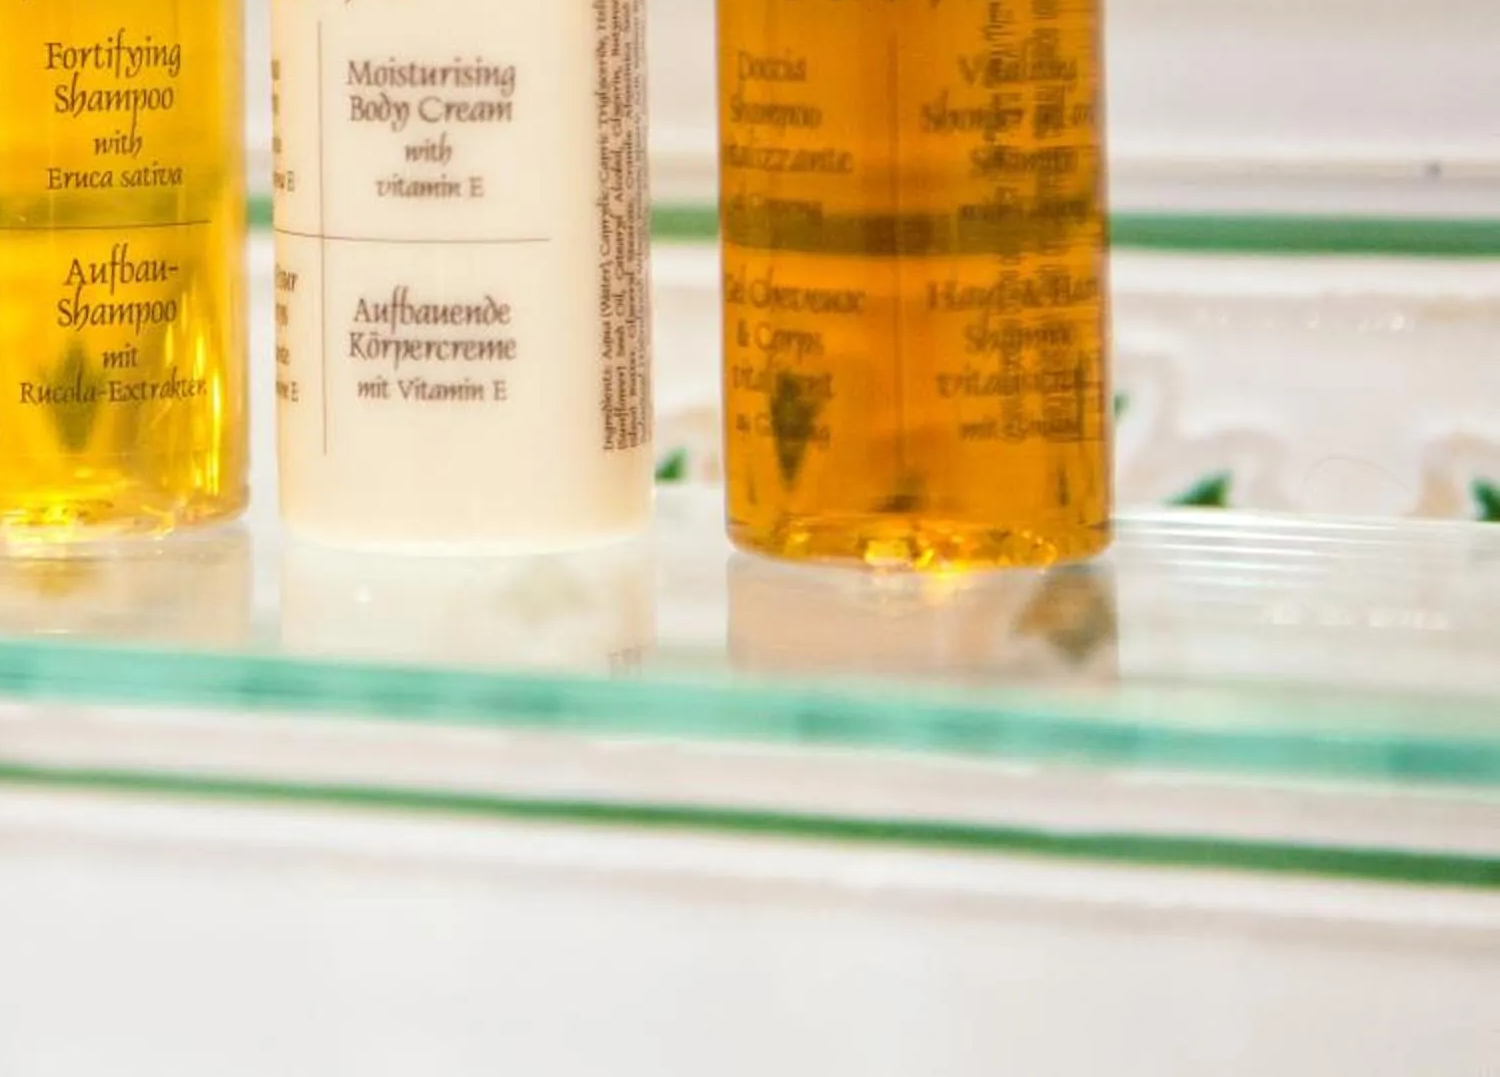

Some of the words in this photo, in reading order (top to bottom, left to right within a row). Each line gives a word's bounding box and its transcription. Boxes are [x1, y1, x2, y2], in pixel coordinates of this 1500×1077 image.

[45, 27, 183, 80] Fortifying
[53, 71, 175, 122] Shampoo
[345, 56, 517, 97] Moisturising
[348, 91, 410, 133] Body
[417, 94, 514, 125] Cream
[94, 121, 144, 159] with
[403, 130, 453, 165] with
[46, 166, 114, 191] Eruca
[119, 160, 184, 187] sativa
[375, 172, 461, 199] vitamin
[469, 175, 486, 199] E
[62, 242, 180, 297] Aufbau-
[56, 284, 178, 333] Shampoo
[352, 284, 513, 335] Aufbauende
[102, 342, 140, 370] mit
[347, 330, 519, 372] Körpercreme
[356, 375, 391, 401] mit
[397, 377, 486, 403] Vitamin
[492, 379, 509, 403] E
